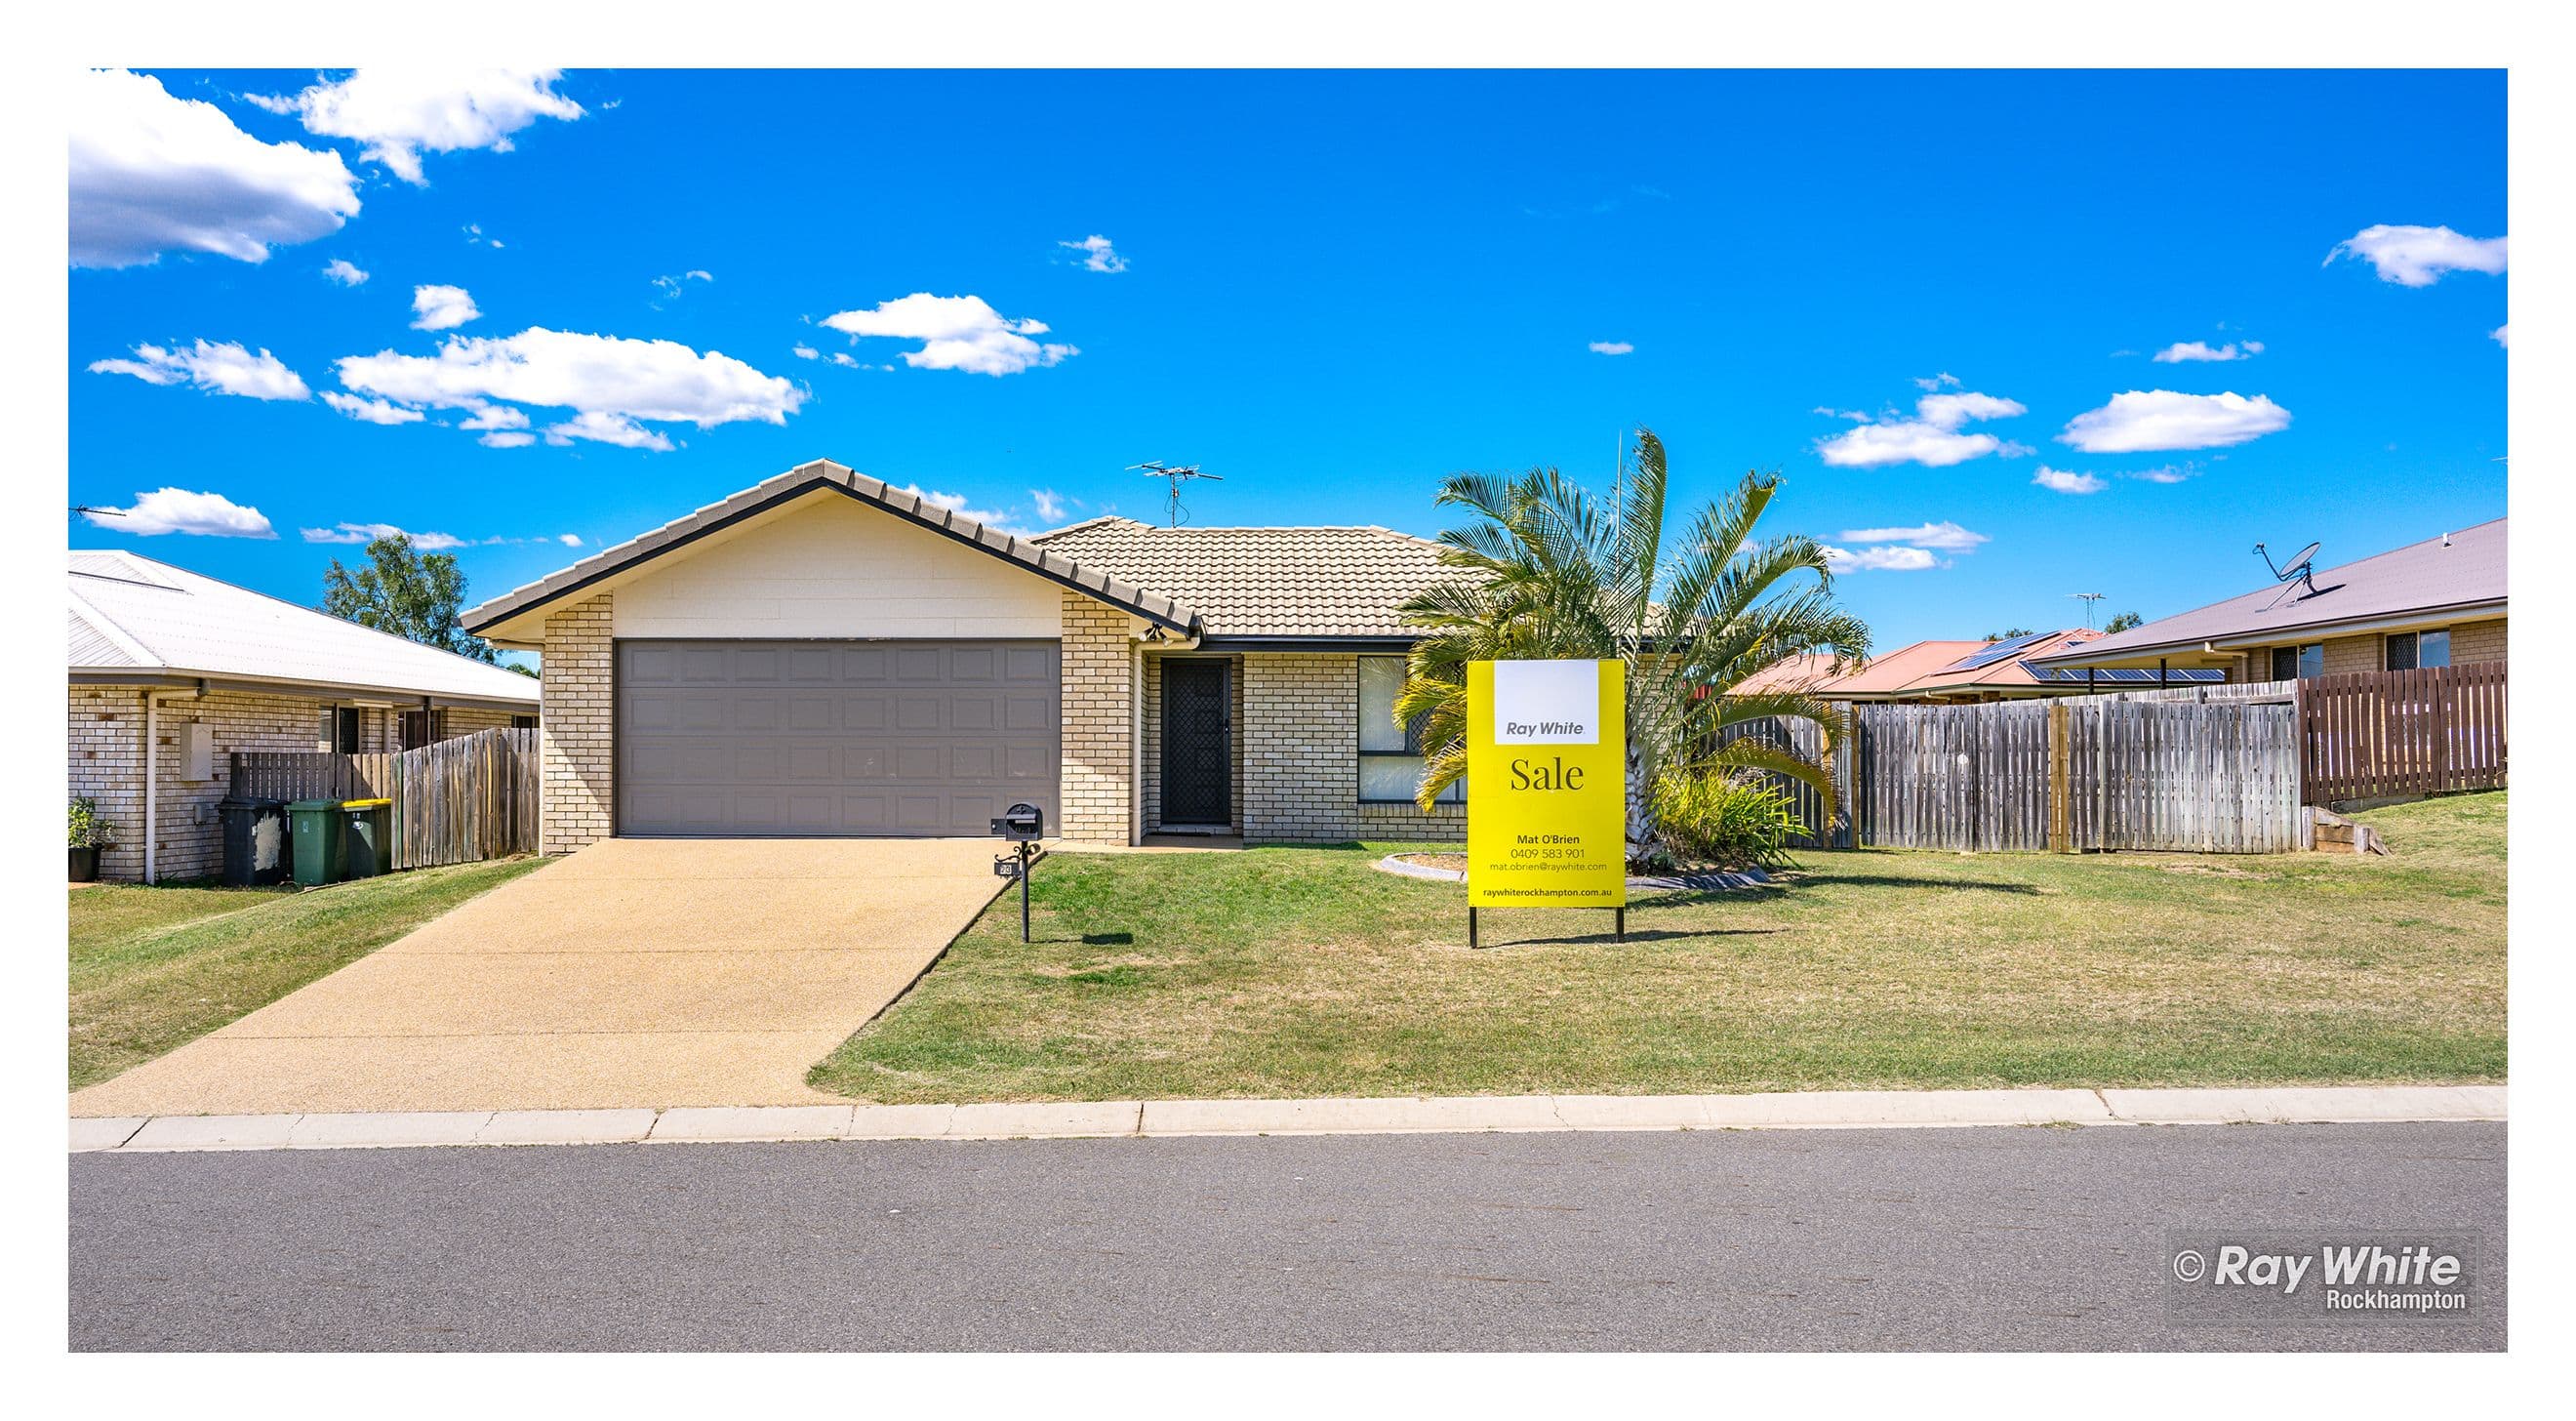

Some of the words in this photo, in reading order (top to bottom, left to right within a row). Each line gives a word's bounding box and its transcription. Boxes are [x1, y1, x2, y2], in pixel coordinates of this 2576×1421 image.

[1507, 721, 1537, 737] Ray
[1540, 721, 1584, 735] White
[1510, 756, 1585, 792] Sale
[1517, 834, 1539, 844] Mat
[1542, 834, 1580, 844] O'Brien
[1510, 848, 1538, 859] 0409
[1542, 848, 1563, 859] 583
[1565, 848, 1585, 859] 901
[1490, 861, 1608, 872] mat.obrien@raywhite.com
[1483, 888, 1613, 899] raywhiterockhampton.com.au
